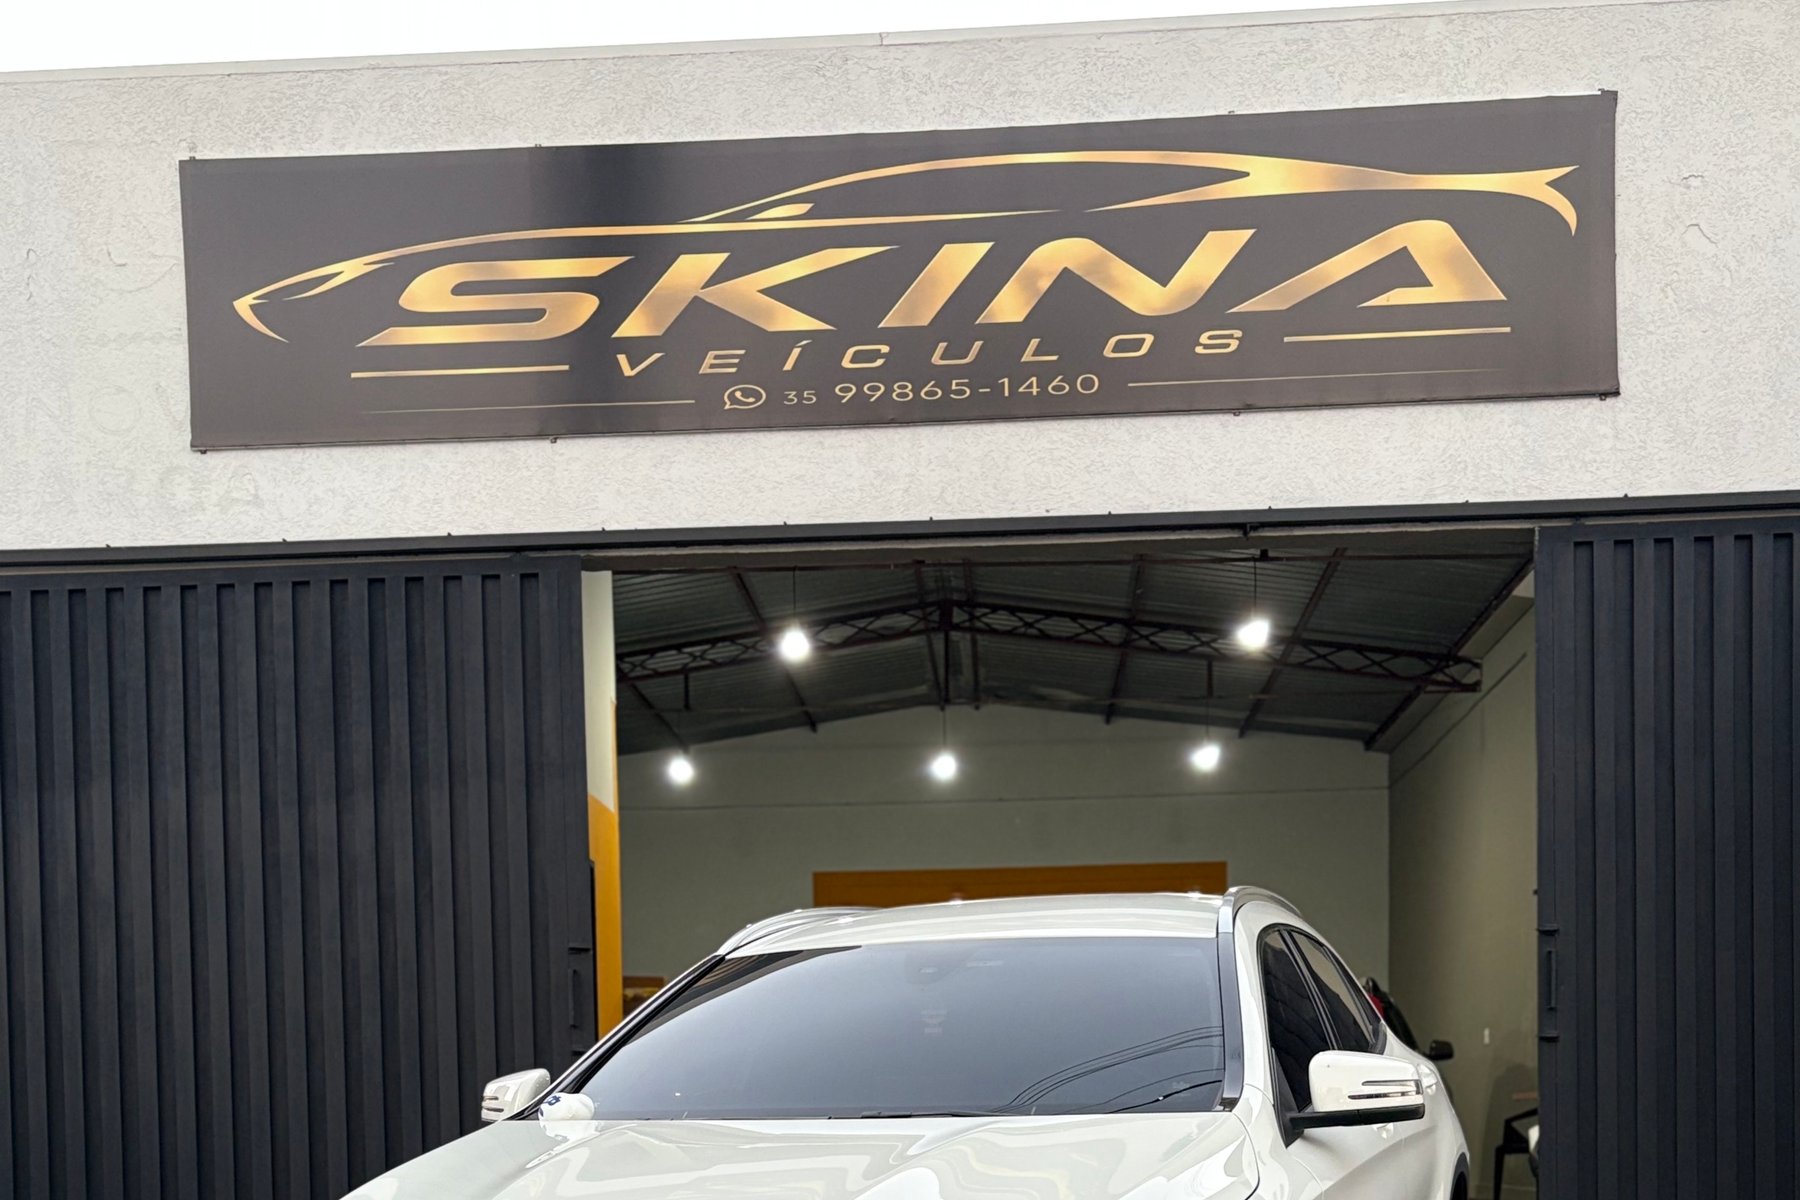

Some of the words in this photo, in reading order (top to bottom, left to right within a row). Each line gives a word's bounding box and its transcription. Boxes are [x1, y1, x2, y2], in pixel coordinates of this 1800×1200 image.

[356, 219, 1507, 347] SKINA
[616, 328, 1243, 377] VEÍCULOS
[783, 390, 817, 405] 35
[834, 373, 1101, 404] 99865-1460
